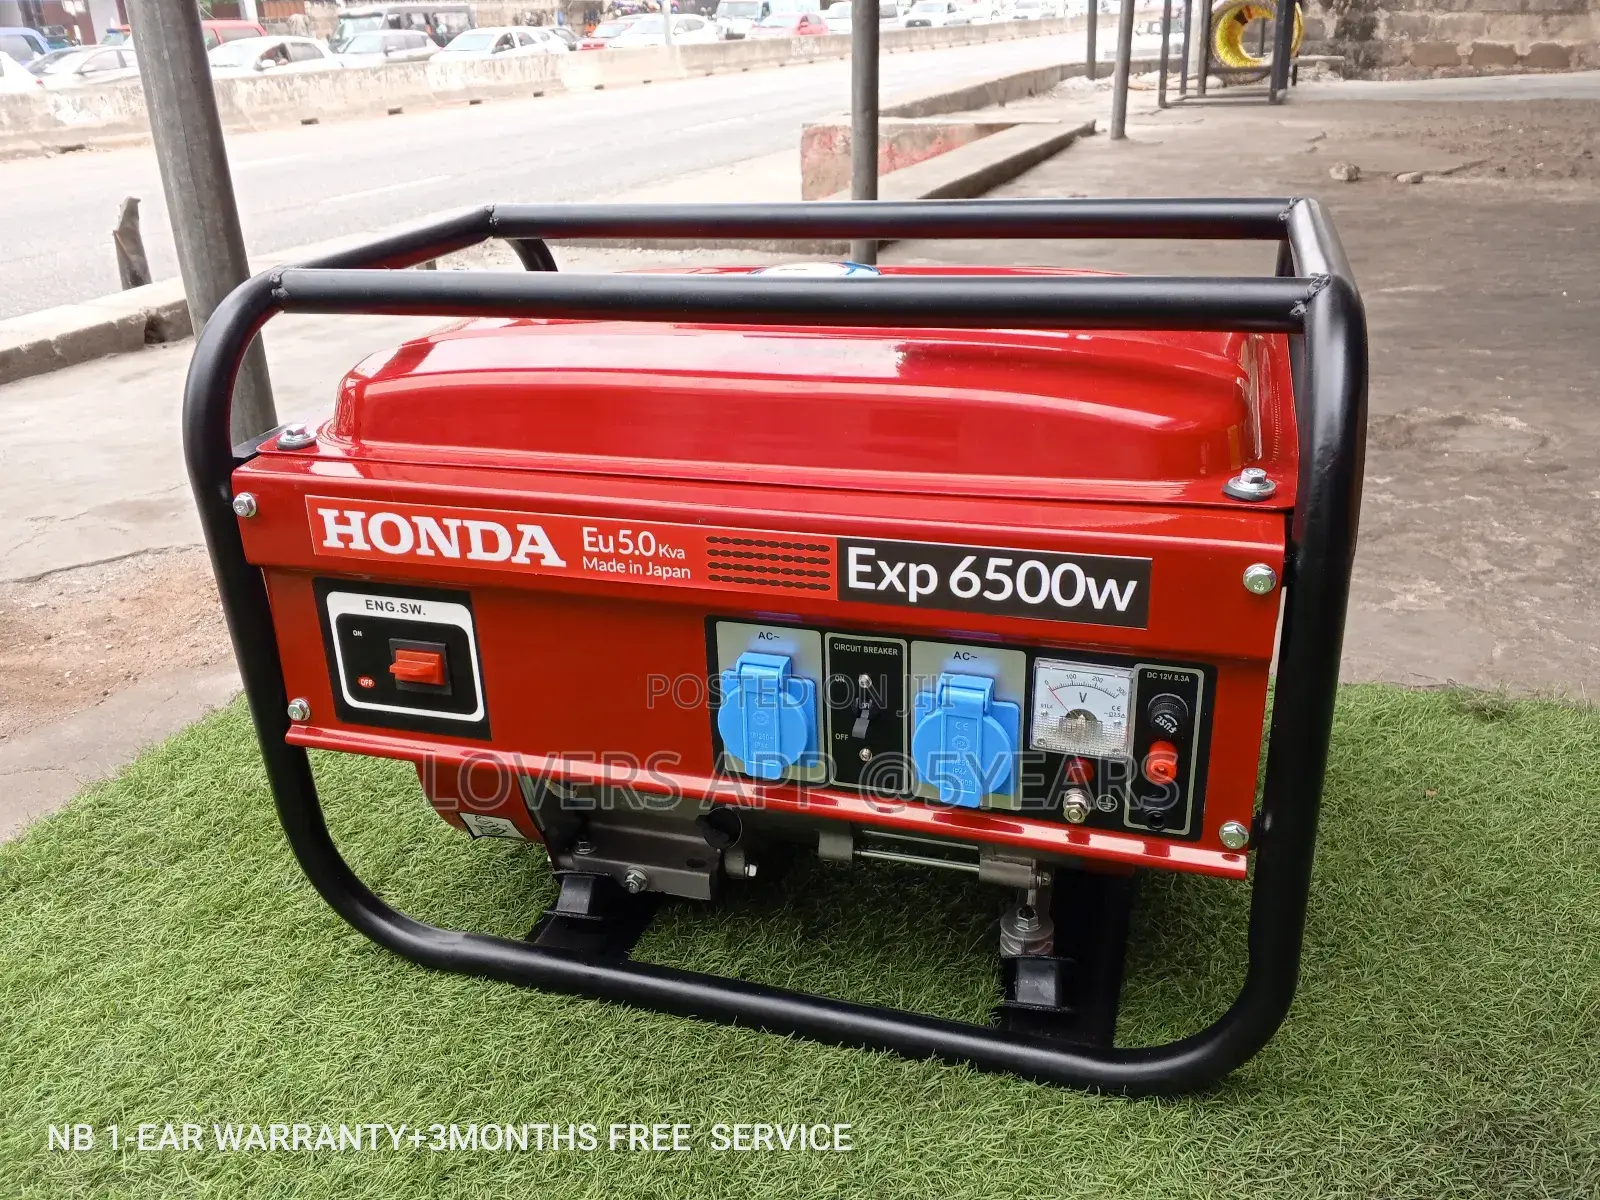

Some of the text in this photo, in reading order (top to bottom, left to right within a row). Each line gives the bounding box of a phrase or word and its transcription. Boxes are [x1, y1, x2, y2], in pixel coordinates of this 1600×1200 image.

[317, 507, 567, 568] HONDA
[582, 526, 686, 560] Eu 5.0 Kva
[582, 555, 691, 580] Made in Japan
[847, 546, 1138, 612] Exp 6500w
[364, 599, 427, 616] ENG.SW.
[352, 629, 363, 637] ON
[833, 643, 898, 656] CIRCUIT BREAKER
[360, 679, 373, 688] OFF
[1091, 675, 1104, 684] 200
[1146, 671, 1190, 683] DC 12V 8.3A
[1079, 691, 1088, 704] V
[1116, 686, 1127, 697] 300
[1154, 715, 1178, 734] FUSE
[835, 733, 849, 741] OFF
